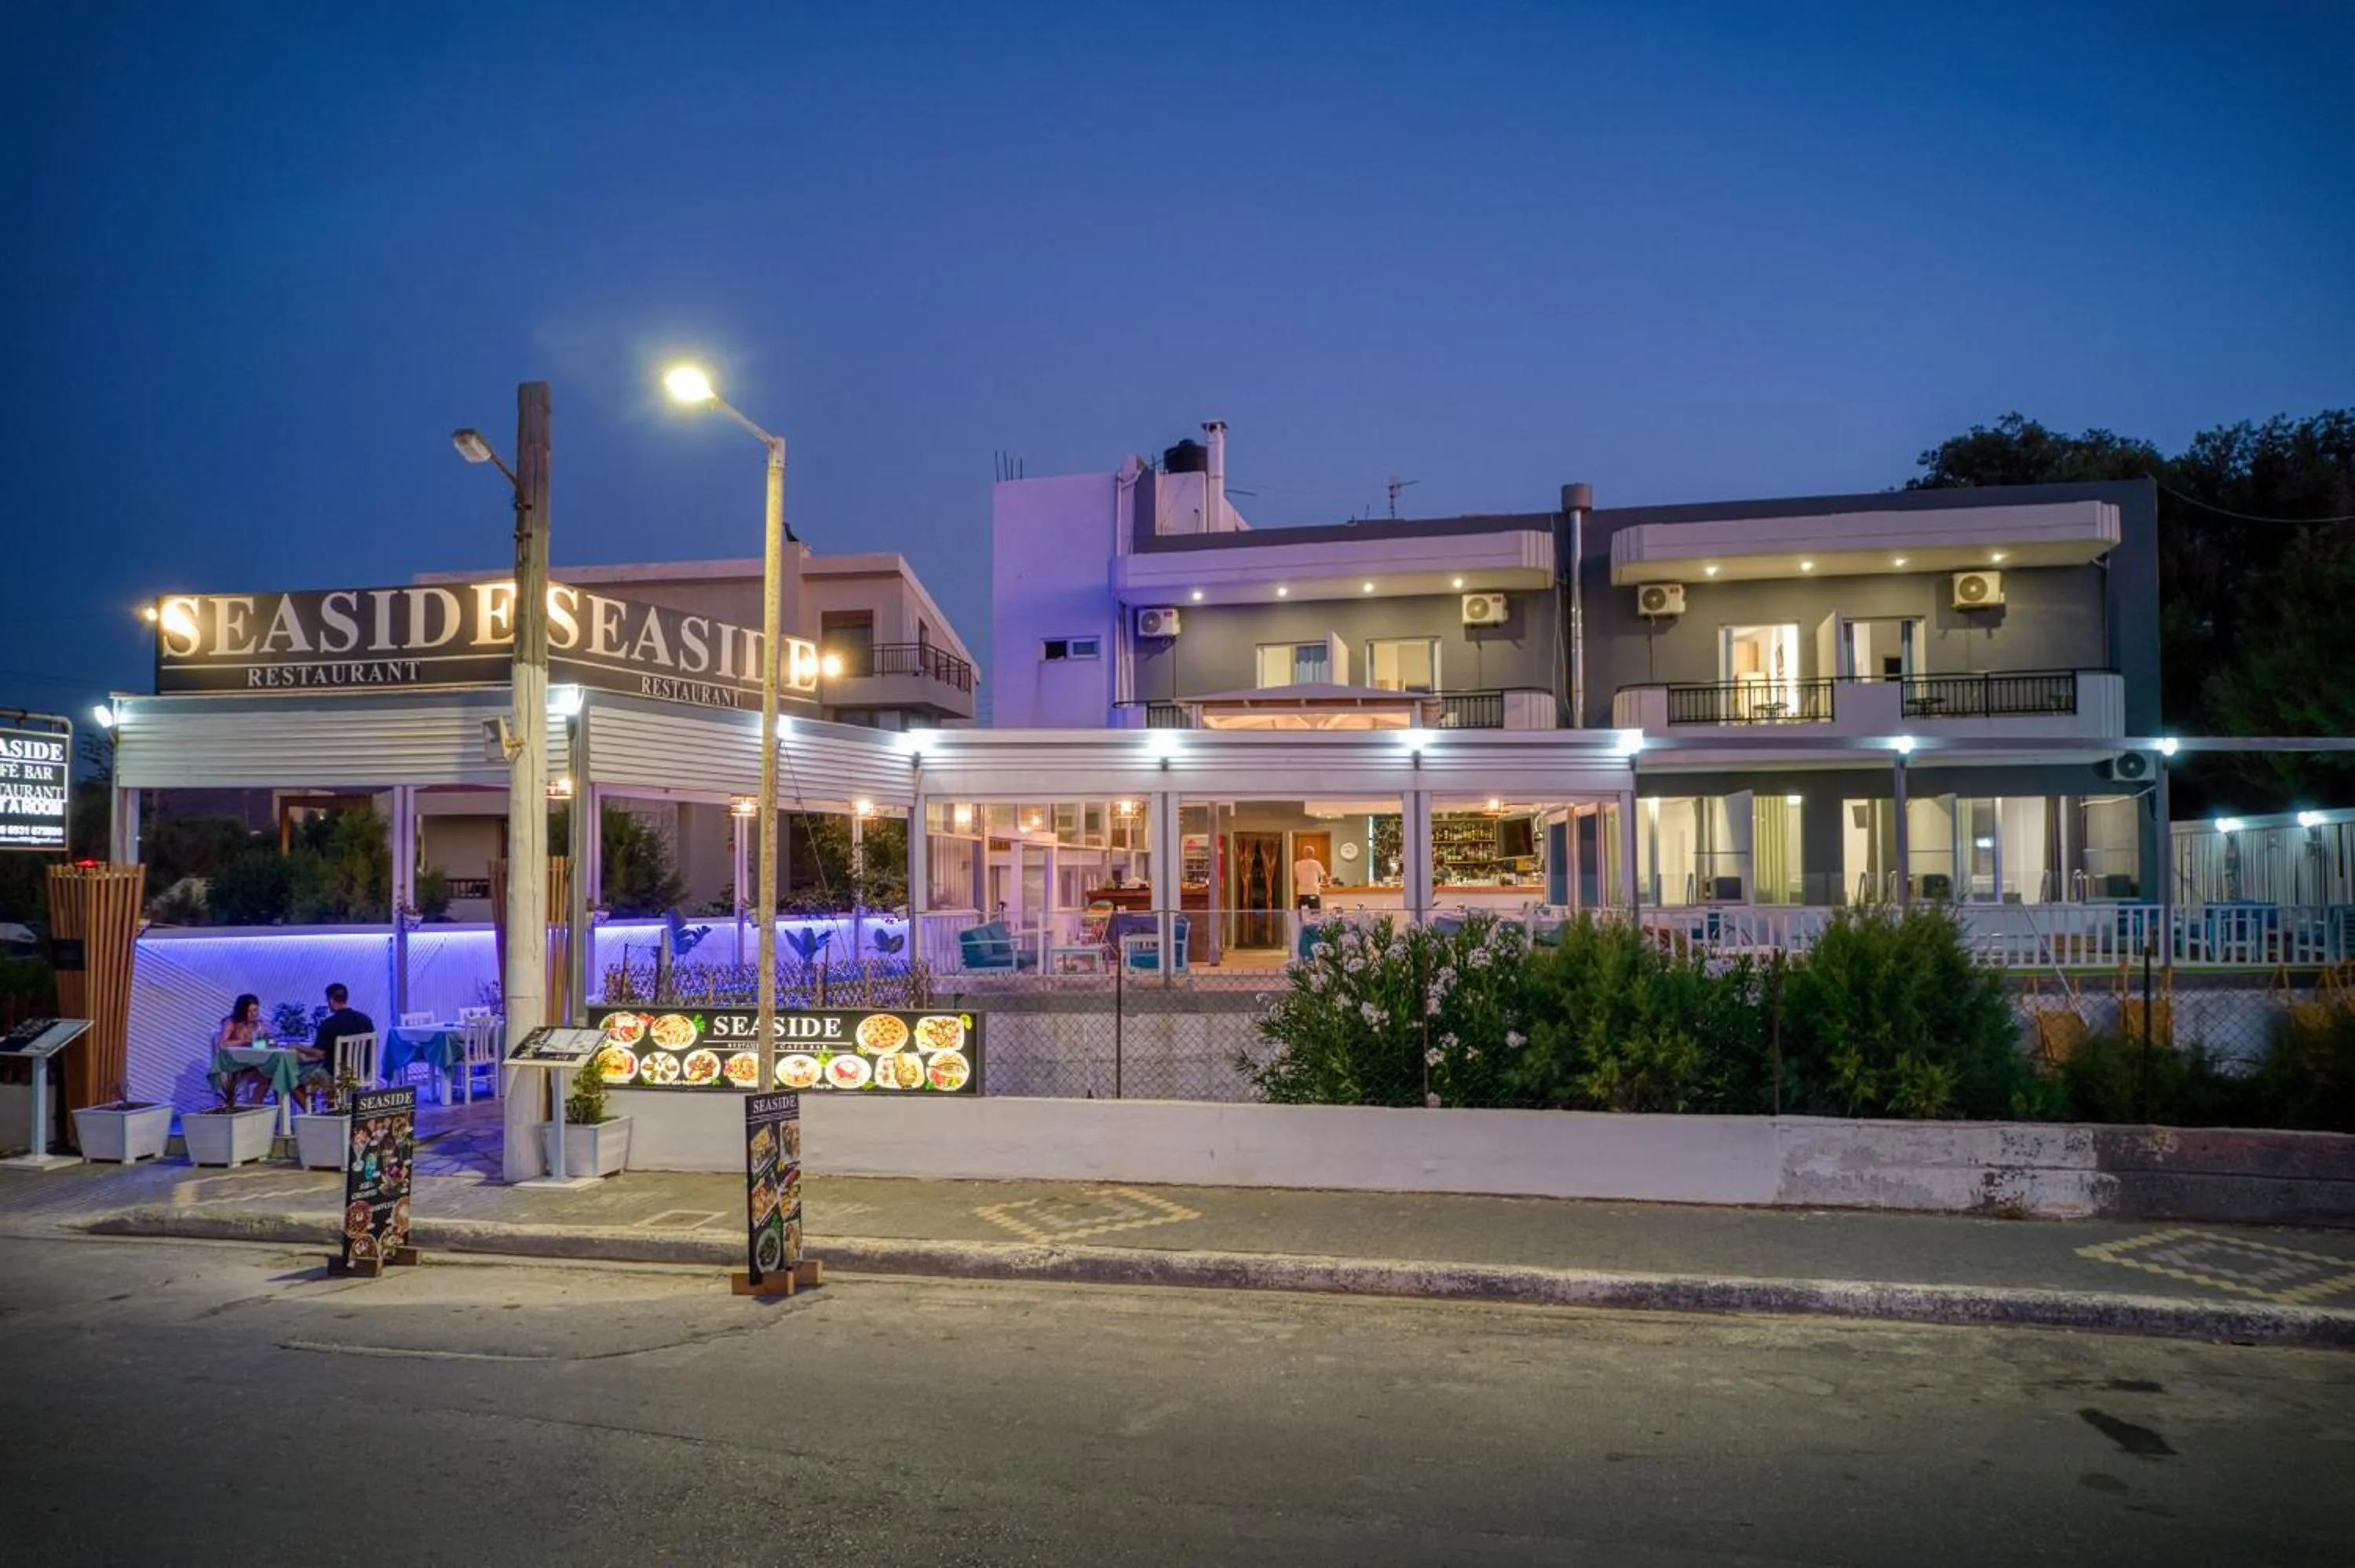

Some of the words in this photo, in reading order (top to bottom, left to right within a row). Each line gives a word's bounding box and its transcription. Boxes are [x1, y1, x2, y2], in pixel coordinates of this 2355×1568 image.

[161, 582, 515, 658] SEASIDE
[247, 661, 421, 687] RESTAURANT
[641, 675, 740, 707] RESTAURANT
[24, 765, 53, 781] BAR
[359, 1092, 412, 1110] SEASIDE
[753, 1095, 798, 1114] SEASIDE
